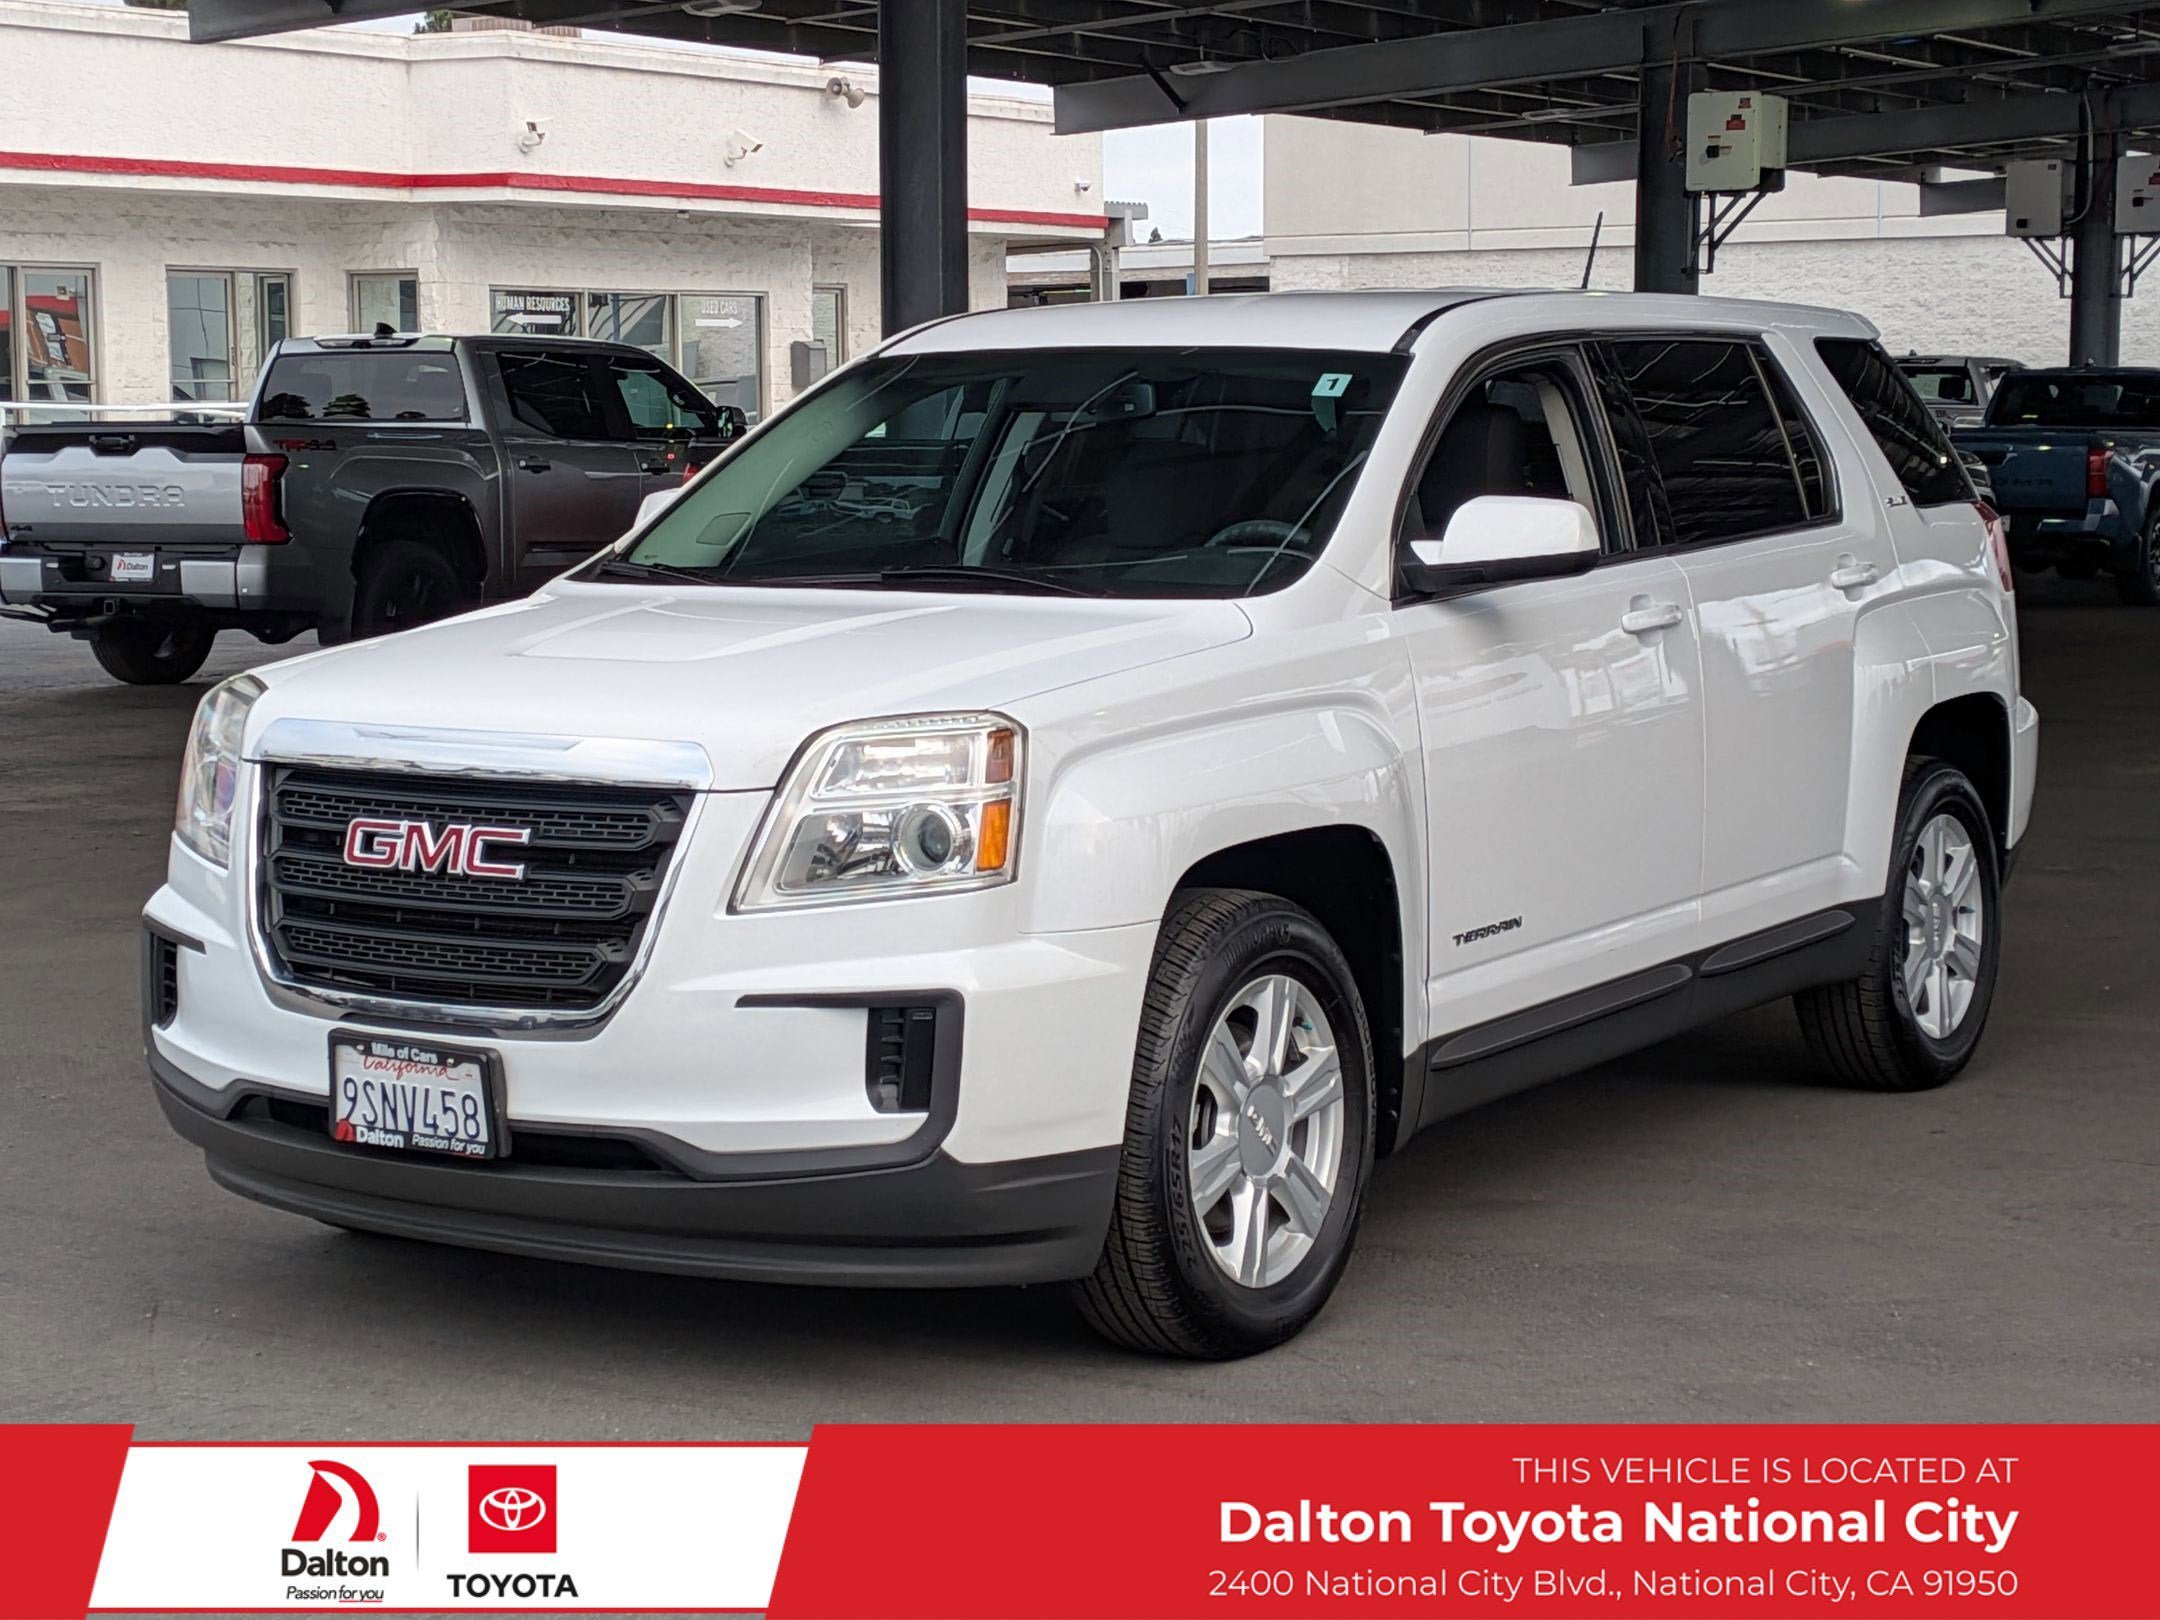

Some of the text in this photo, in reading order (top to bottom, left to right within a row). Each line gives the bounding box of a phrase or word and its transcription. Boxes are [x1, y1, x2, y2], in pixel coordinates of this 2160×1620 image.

[495, 295, 571, 312] HUMAN RESOURCES
[46, 483, 186, 508] TUNDRA
[344, 816, 532, 881] GMC
[1452, 916, 1523, 947] TERRAIN
[371, 1042, 439, 1065] Mile of Cars
[344, 1077, 481, 1140] 9SNV458
[356, 1126, 405, 1149] Dalton
[412, 1133, 486, 1156] Passion for you
